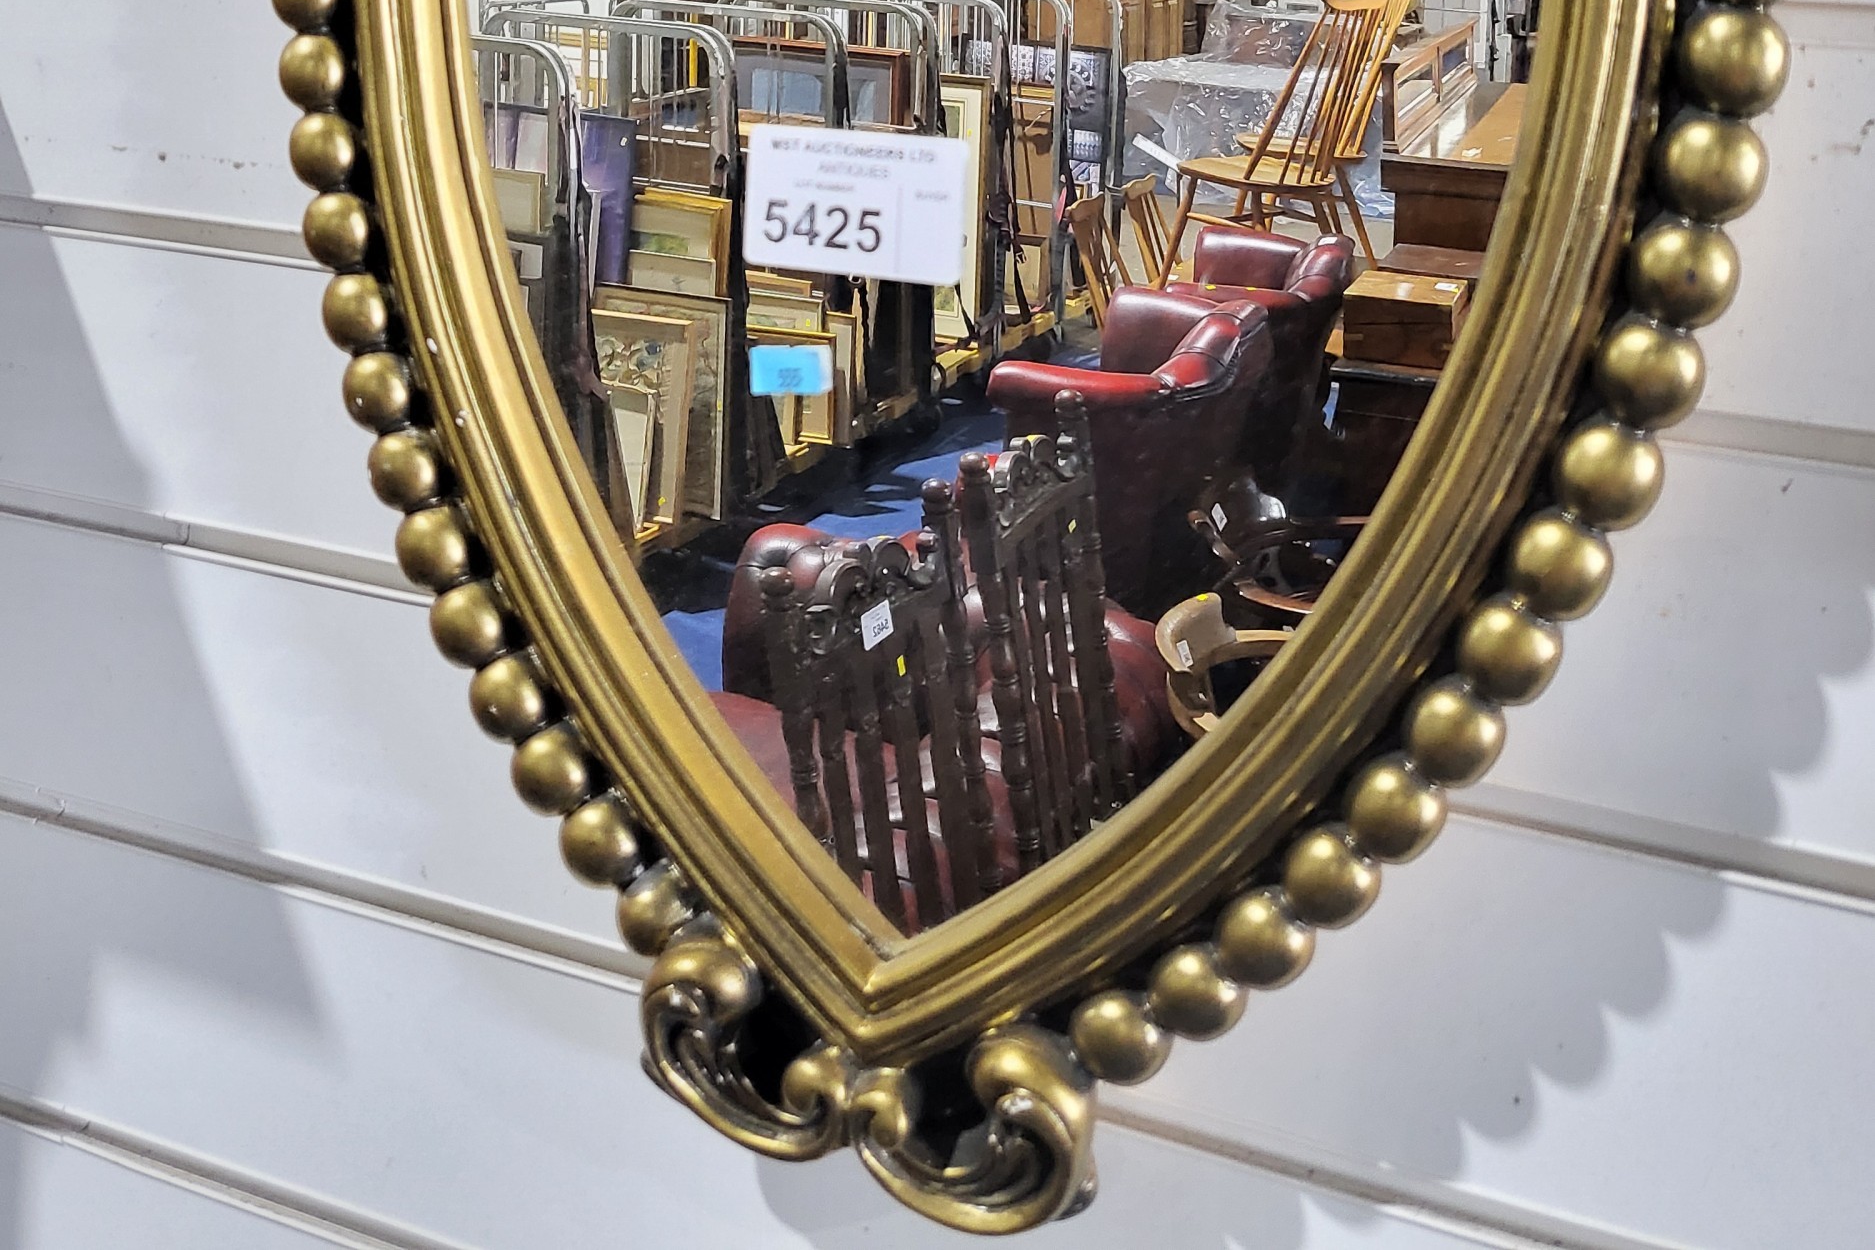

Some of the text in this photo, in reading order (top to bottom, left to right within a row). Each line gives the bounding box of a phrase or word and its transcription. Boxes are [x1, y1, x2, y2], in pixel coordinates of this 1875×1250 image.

[804, 140, 904, 160] AUCTIONEERS
[818, 160, 890, 179] ANTIQUES
[764, 199, 882, 253] 5425
